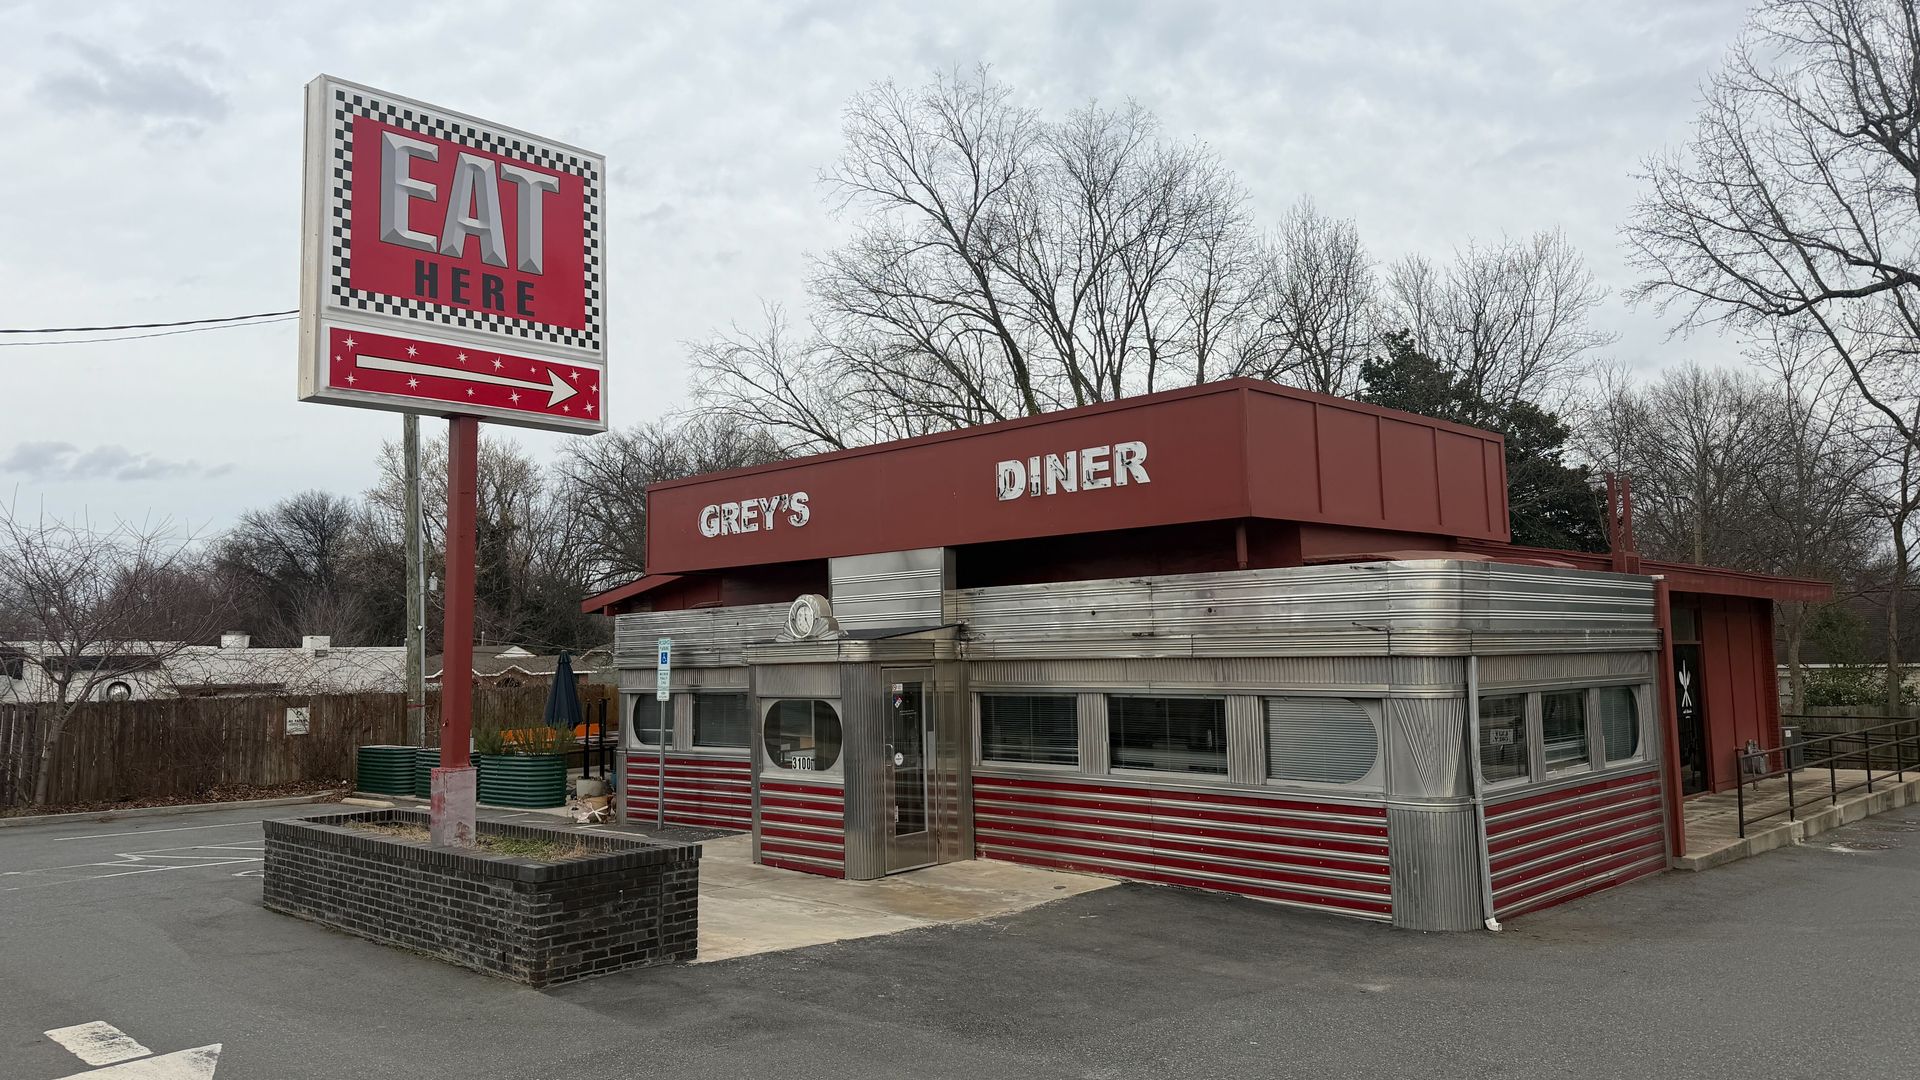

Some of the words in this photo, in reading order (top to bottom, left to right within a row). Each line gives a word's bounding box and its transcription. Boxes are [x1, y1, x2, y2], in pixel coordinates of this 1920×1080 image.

[380, 130, 560, 276] EAT
[415, 259, 536, 317] HERE
[699, 491, 810, 537] GREY'S
[996, 440, 1150, 501] DINER
[792, 757, 811, 770] 3100
